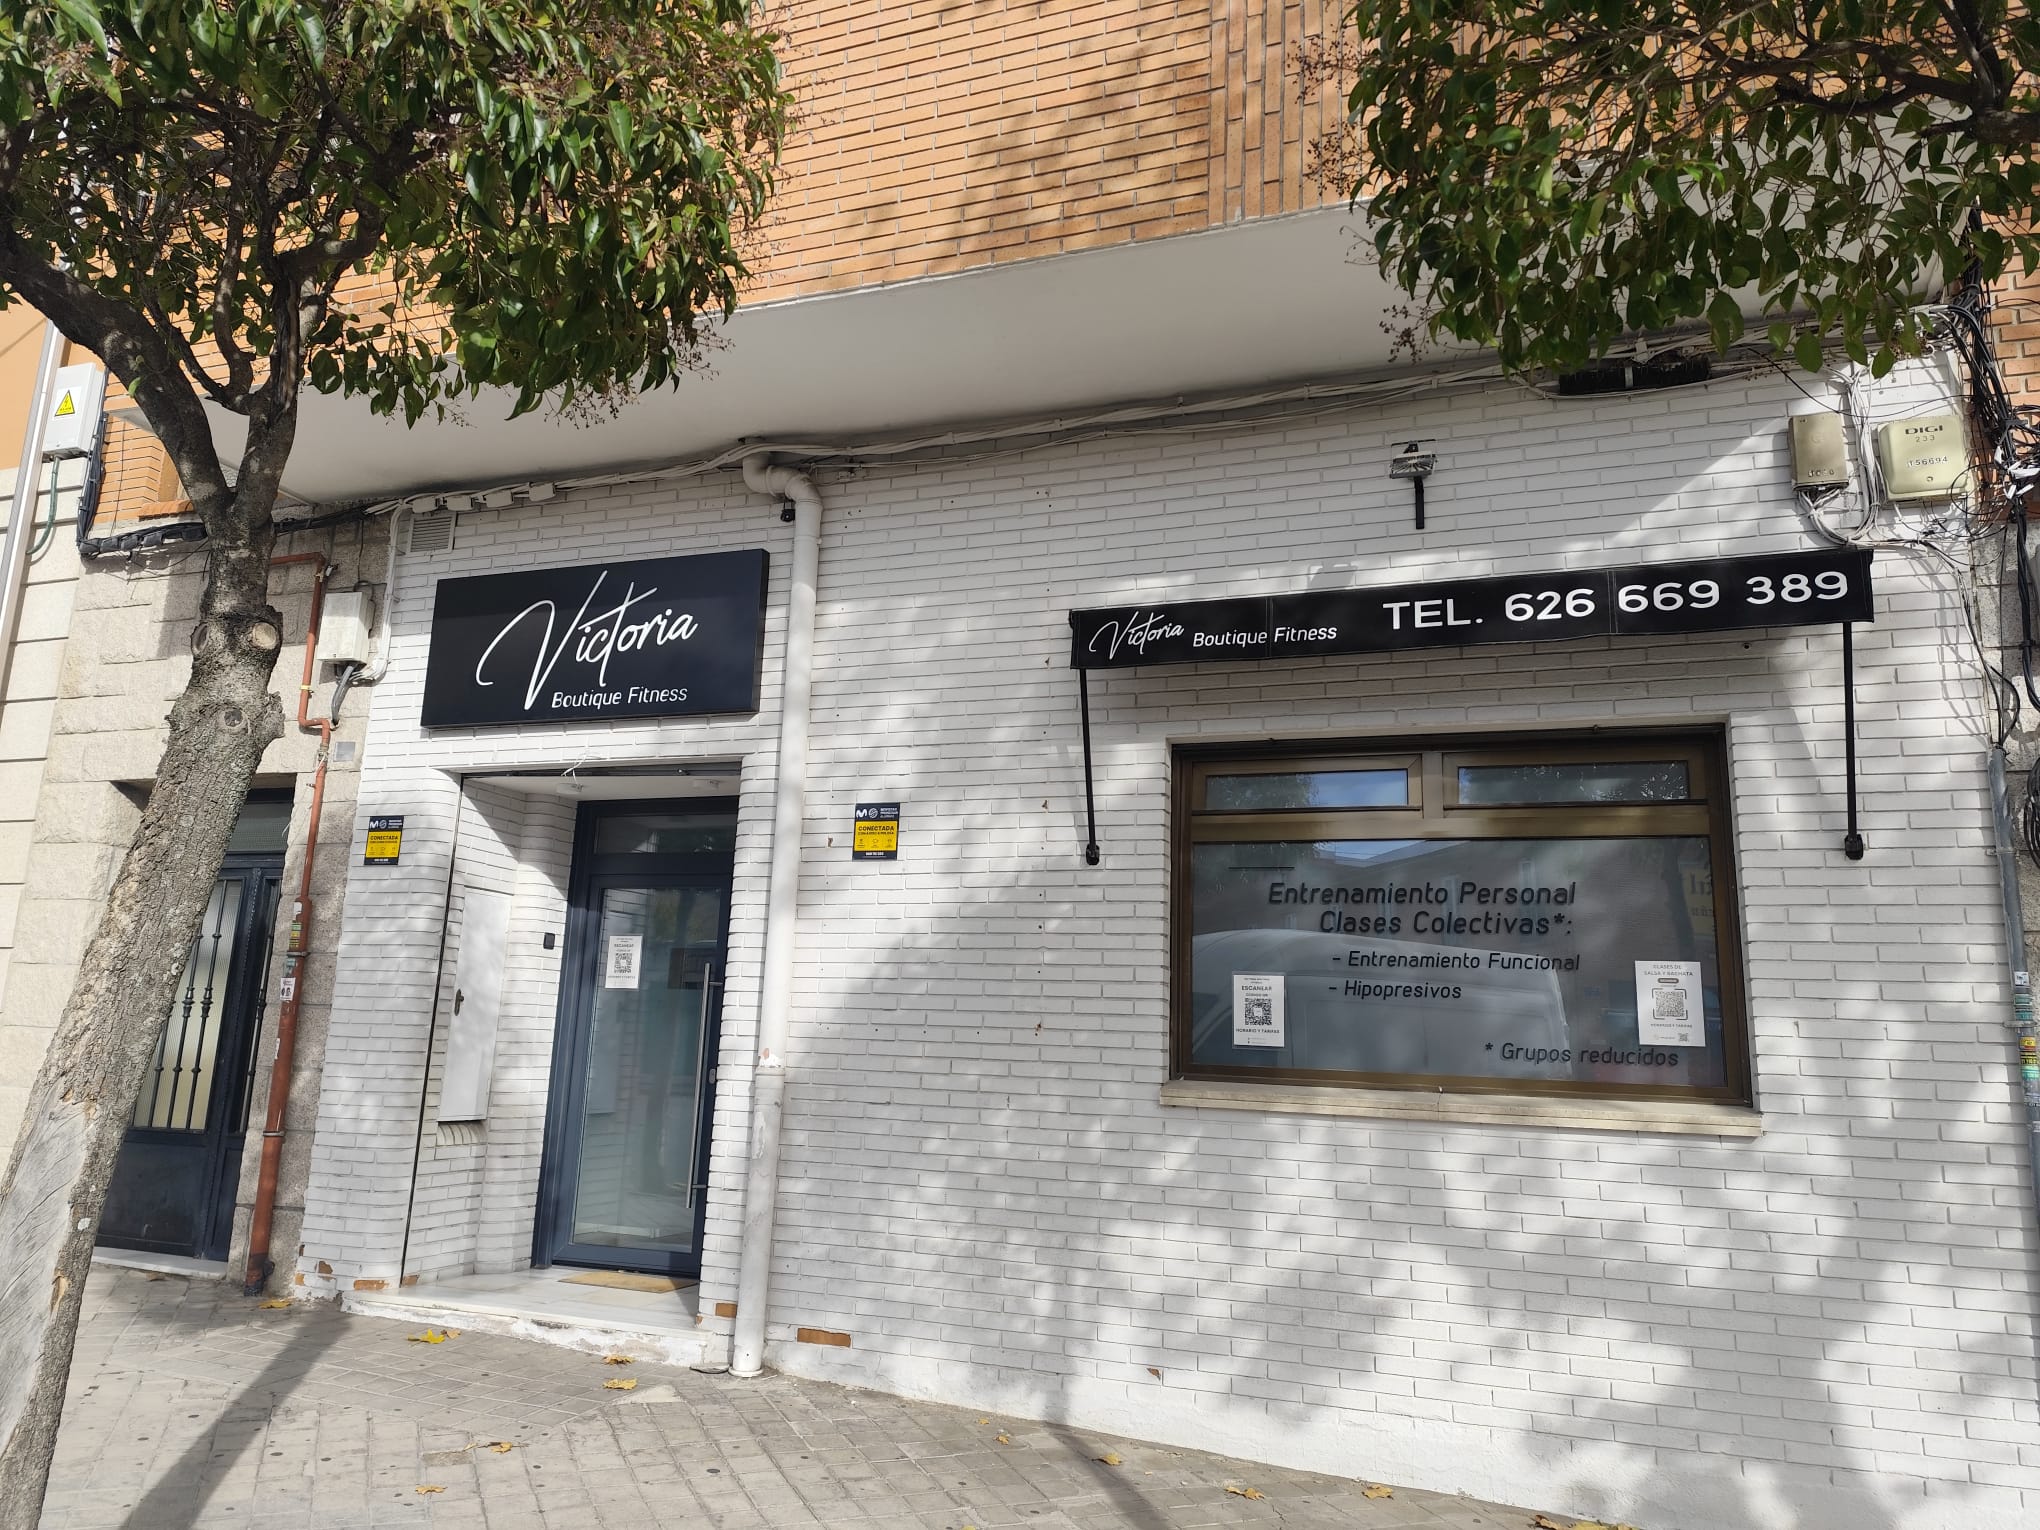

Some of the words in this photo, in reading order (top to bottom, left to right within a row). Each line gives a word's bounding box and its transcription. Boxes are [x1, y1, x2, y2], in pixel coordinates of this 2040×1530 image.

[1905, 425, 1943, 435] DIGI
[1915, 435, 1935, 443] 233
[1382, 599, 1483, 630] TEL.
[1504, 588, 1596, 622] 626
[1617, 579, 1721, 613] 669
[1745, 571, 1848, 605] 389
[476, 570, 699, 711] Victoria
[1088, 611, 1184, 660] Victoria
[1193, 630, 1268, 648] Boutique
[1274, 626, 1338, 644] Fitness
[551, 690, 622, 710] Boutique
[627, 686, 688, 705] Fitness
[1268, 882, 1448, 906] Entrenamiento
[1459, 881, 1577, 905] Personal
[1320, 910, 1401, 934] Clases
[1348, 951, 1480, 969] Entrenamiento
[1488, 953, 1581, 971] Funcional
[1344, 980, 1462, 1001] Hipopresivos
[1501, 1042, 1572, 1064] Grupos
[1580, 1048, 1679, 1067] reducidos
